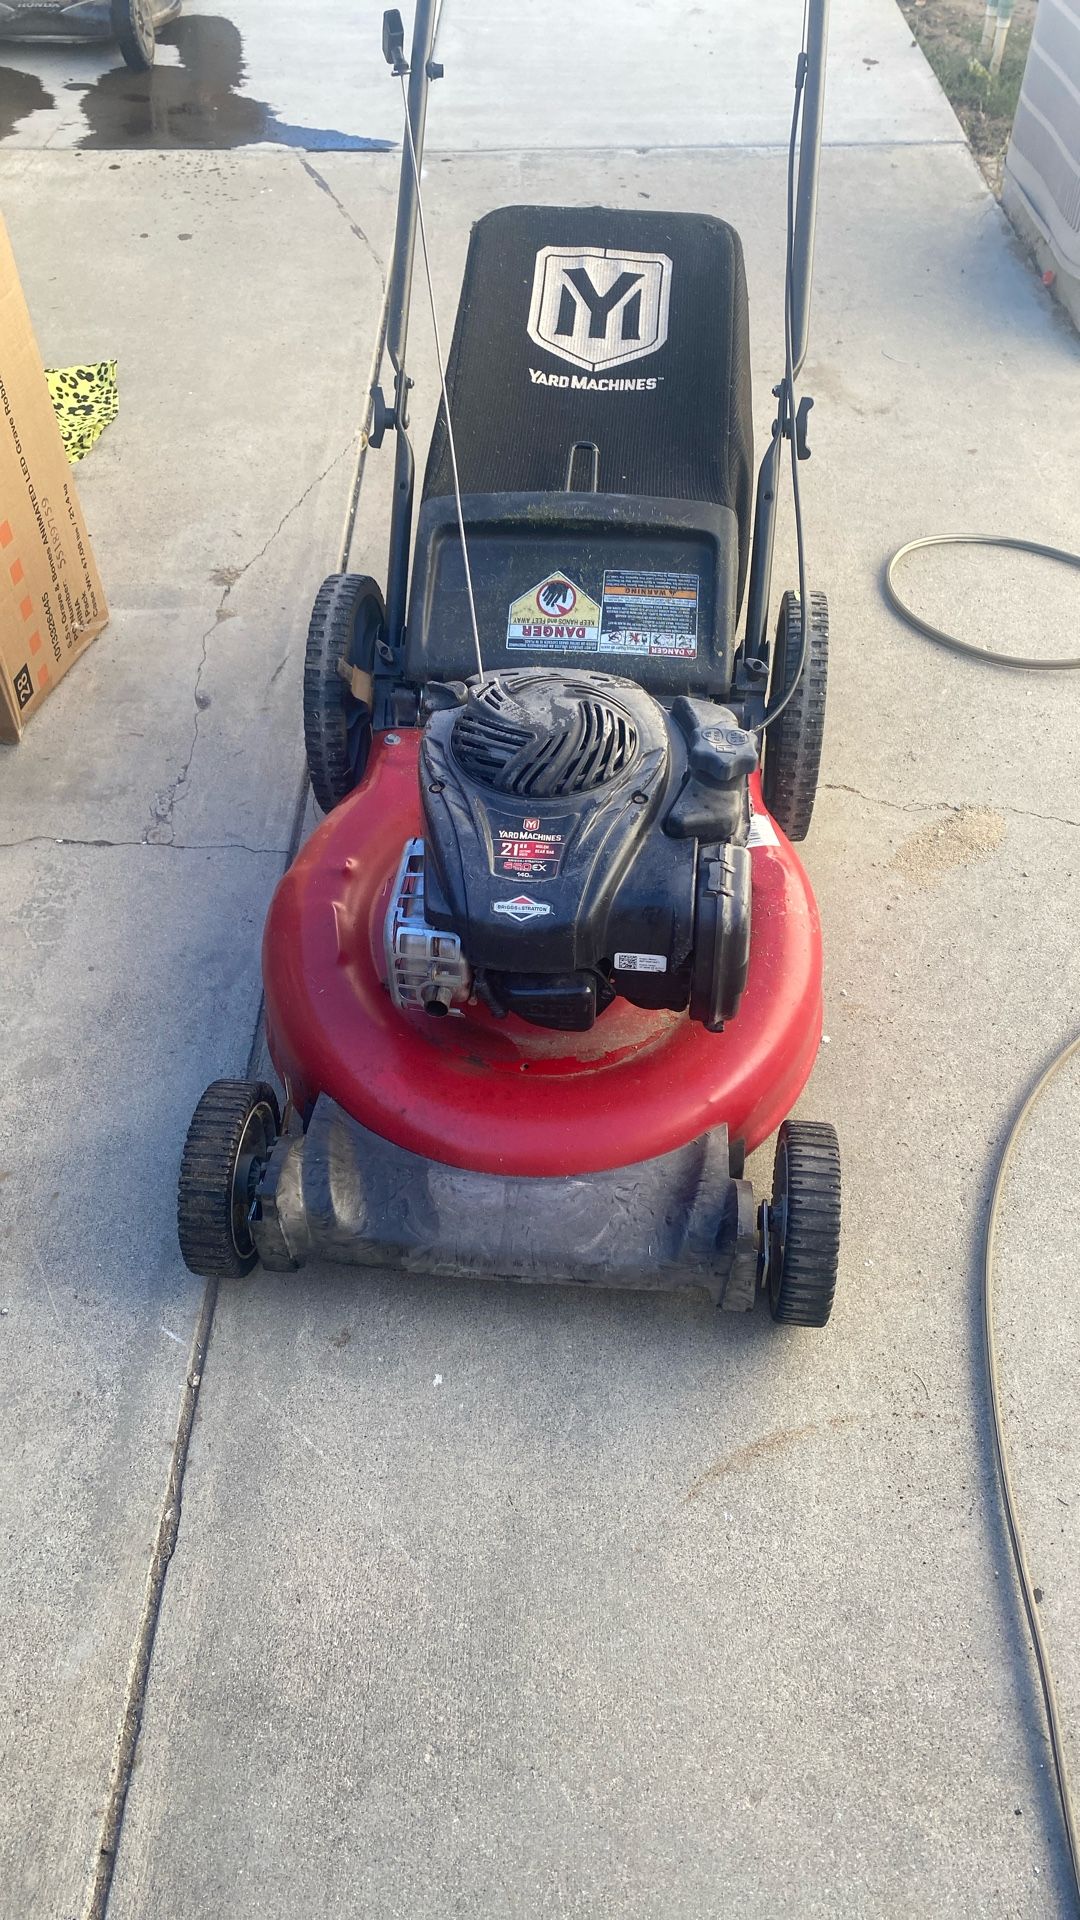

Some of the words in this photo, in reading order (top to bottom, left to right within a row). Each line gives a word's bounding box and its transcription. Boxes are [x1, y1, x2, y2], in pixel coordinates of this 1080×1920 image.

[528, 367, 570, 389] YARD
[7, 416, 22, 455] Grave
[18, 457, 31, 482] LED
[62, 482, 69, 497] kg
[27, 483, 49, 544] ANIMATED
[65, 496, 76, 520] 21.4
[46, 547, 58, 582] Bones
[54, 582, 60, 592] &
[624, 587, 667, 597] WARNING
[56, 592, 68, 624] Grave
[62, 578, 76, 623] Number:
[81, 590, 91, 616] Pack
[90, 590, 99, 617] Case
[41, 591, 63, 663] 1013326445
[522, 625, 586, 639] DANGER
[651, 647, 685, 655] DANGER
[17, 671, 31, 703] 28
[498, 830, 519, 839] YARD
[519, 831, 562, 842] MACHINES
